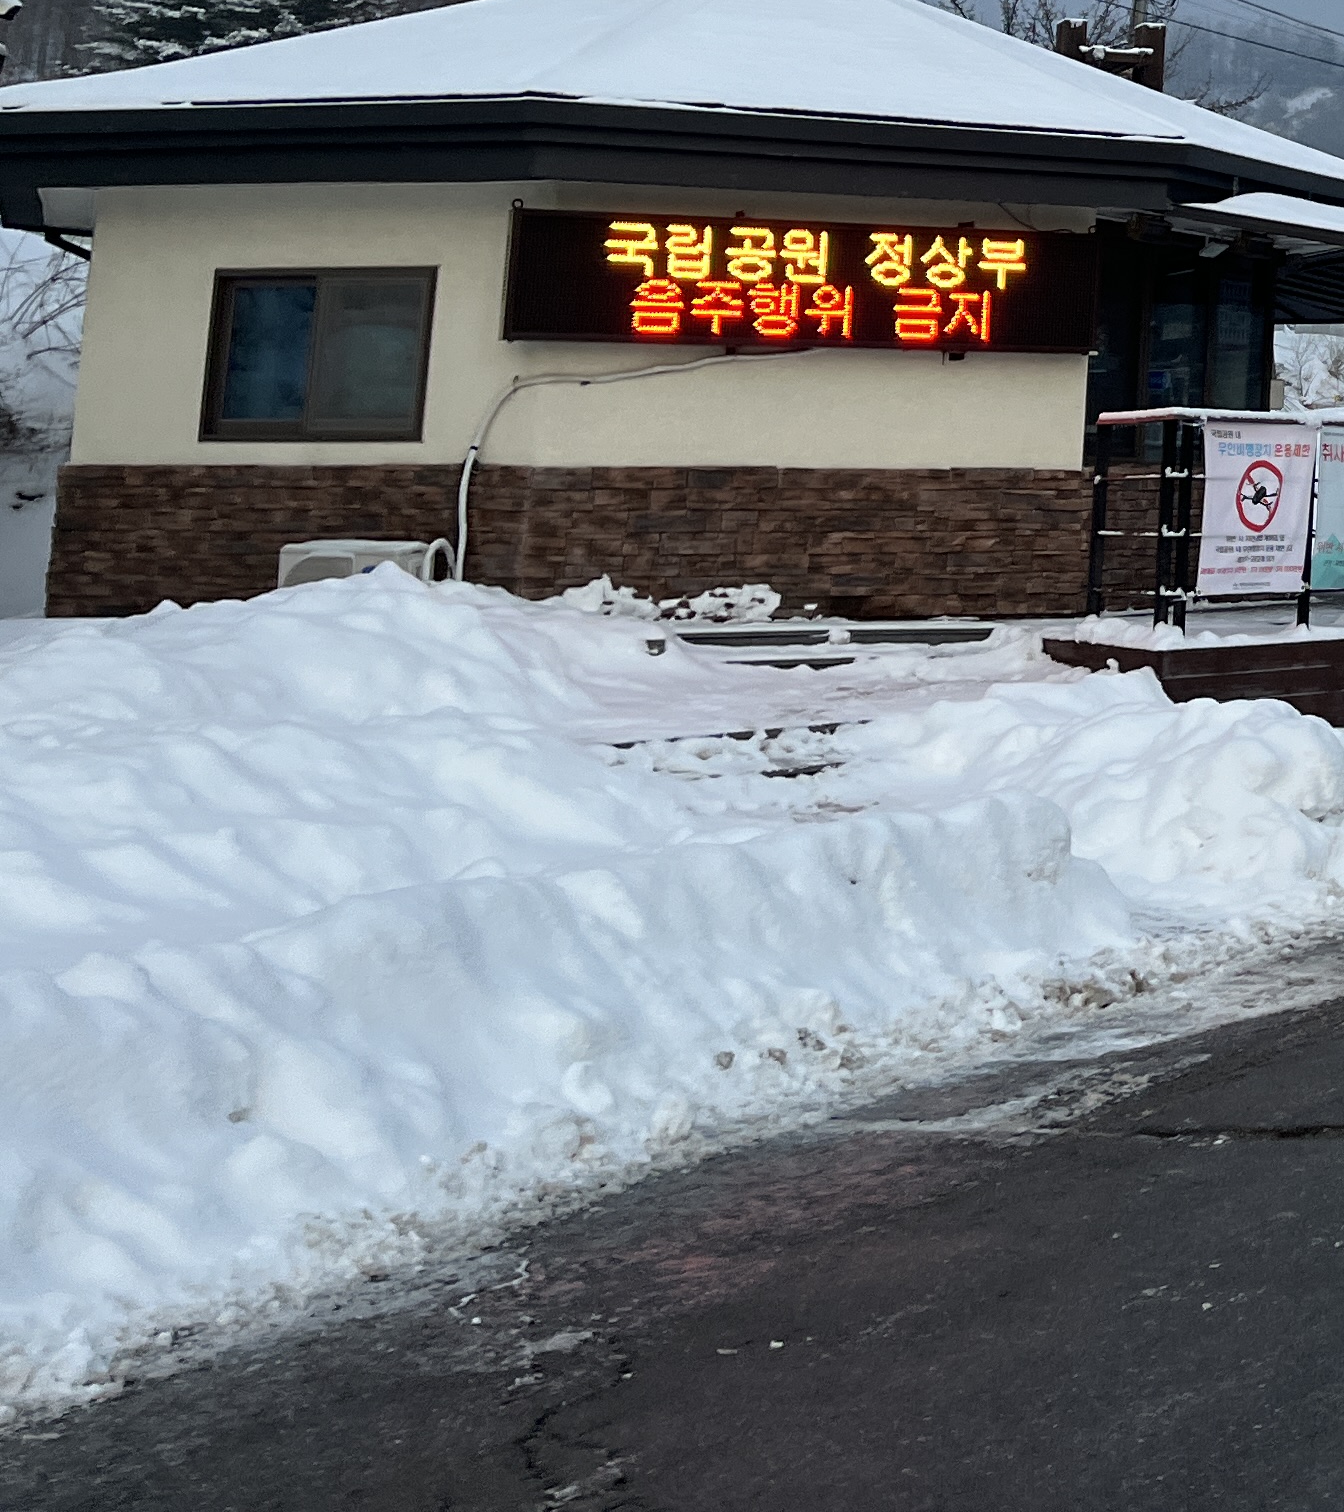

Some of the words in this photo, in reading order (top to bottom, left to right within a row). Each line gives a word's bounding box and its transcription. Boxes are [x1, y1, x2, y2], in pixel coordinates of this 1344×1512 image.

[604, 220, 829, 285] 국립공원
[865, 231, 1027, 290] 정상부
[629, 278, 854, 340] 음주행위
[894, 286, 992, 343] 금지
